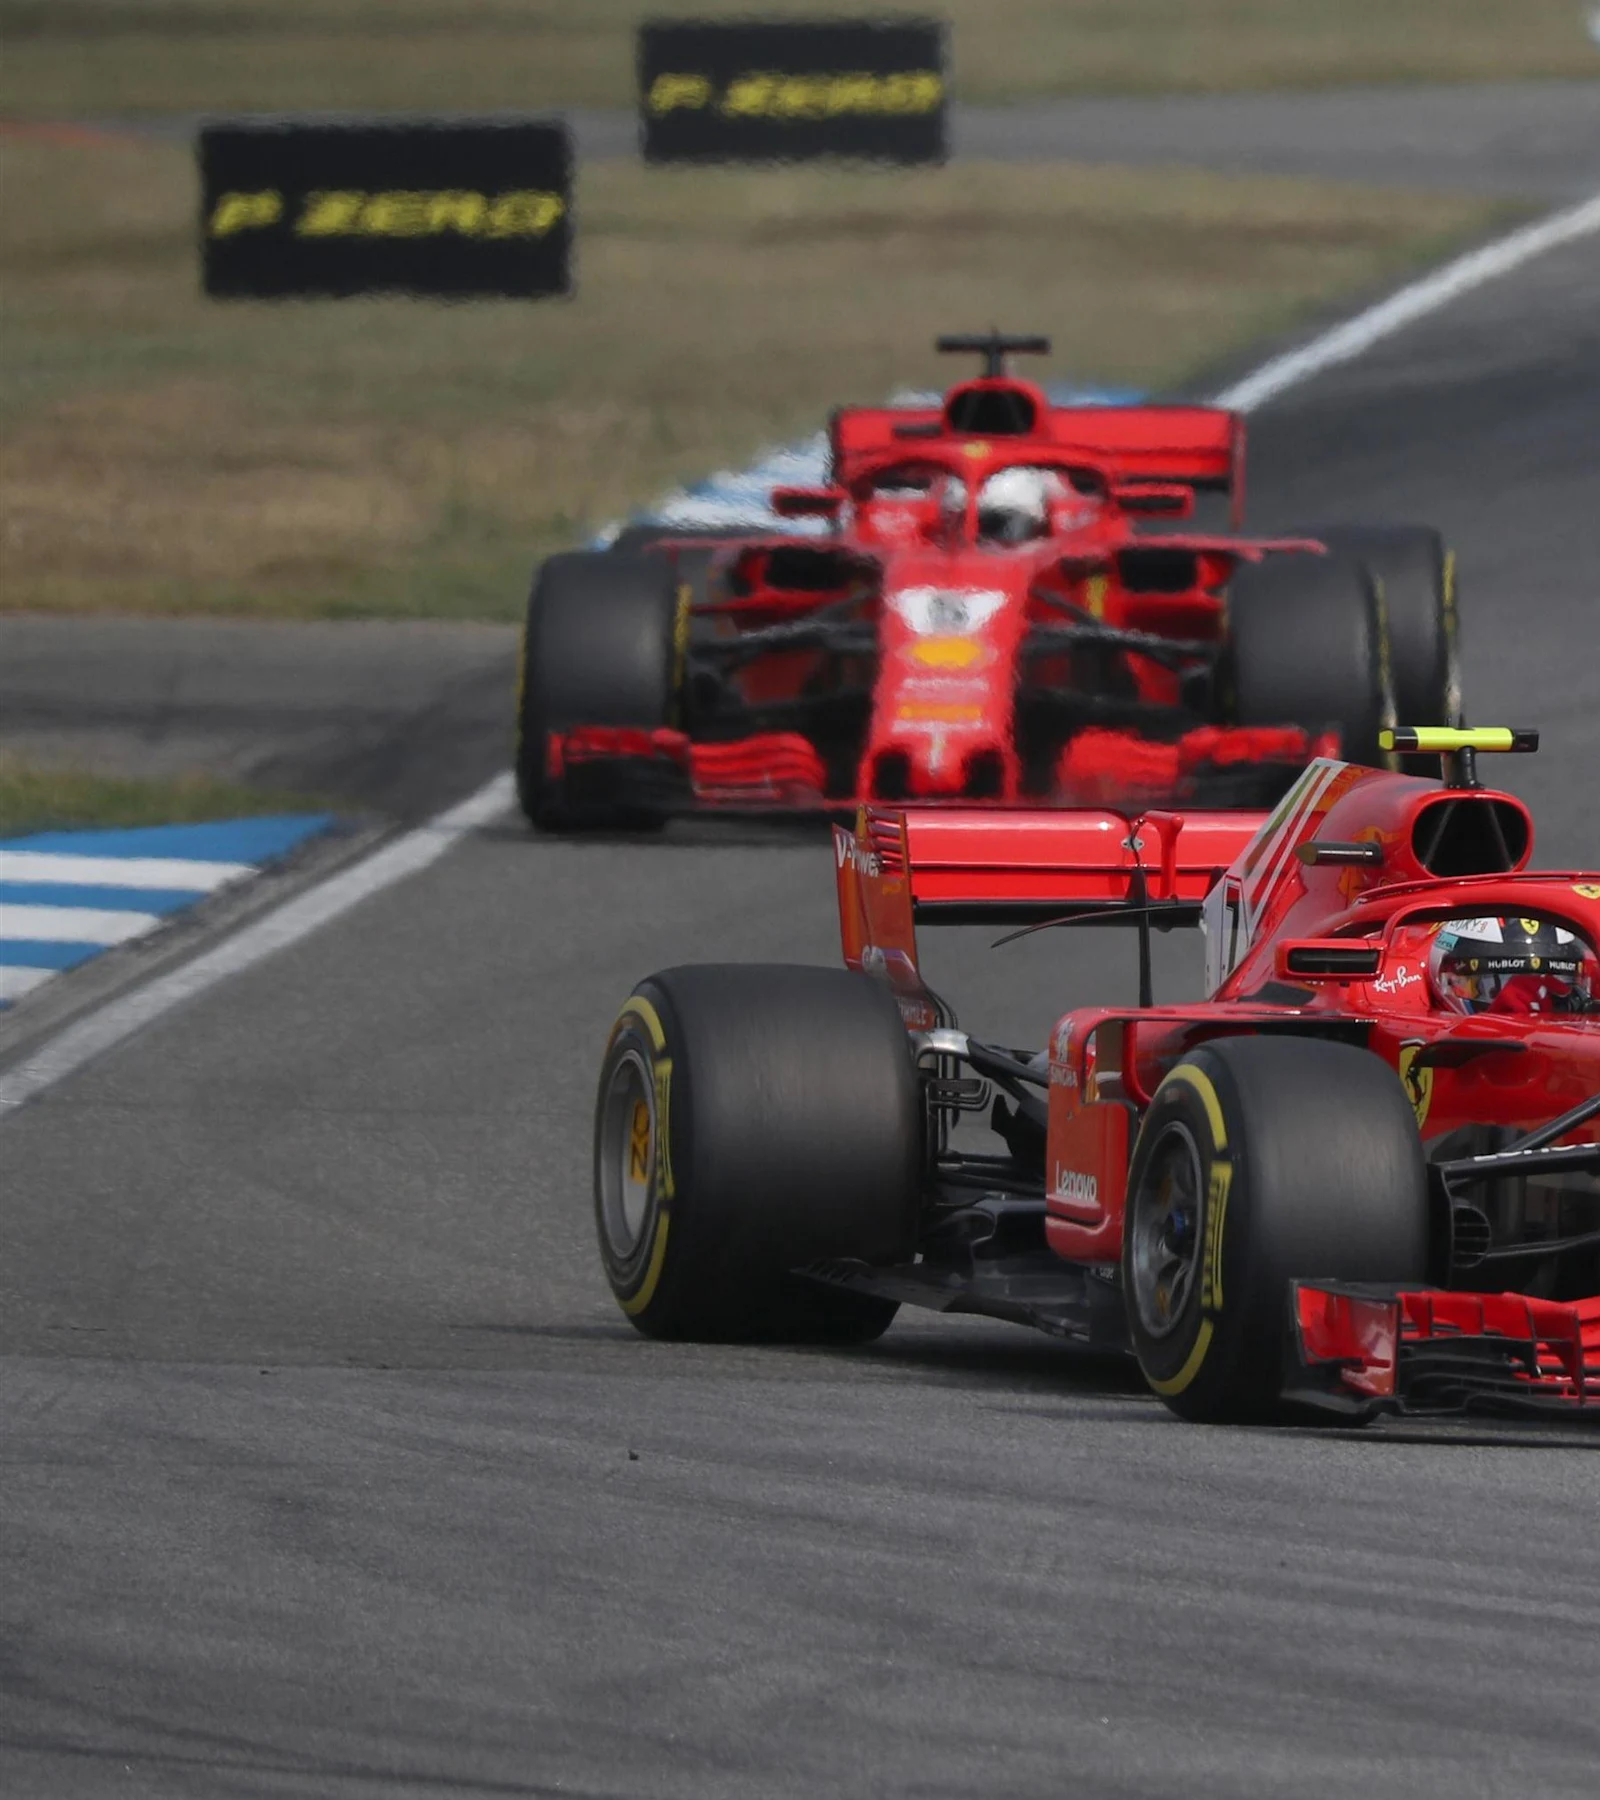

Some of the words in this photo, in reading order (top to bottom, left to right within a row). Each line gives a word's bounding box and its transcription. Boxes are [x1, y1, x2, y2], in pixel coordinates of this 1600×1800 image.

[295, 190, 565, 238] ZERO
[1488, 959, 1525, 969] HUBLOT
[1056, 1161, 1097, 1201] Lenovo
